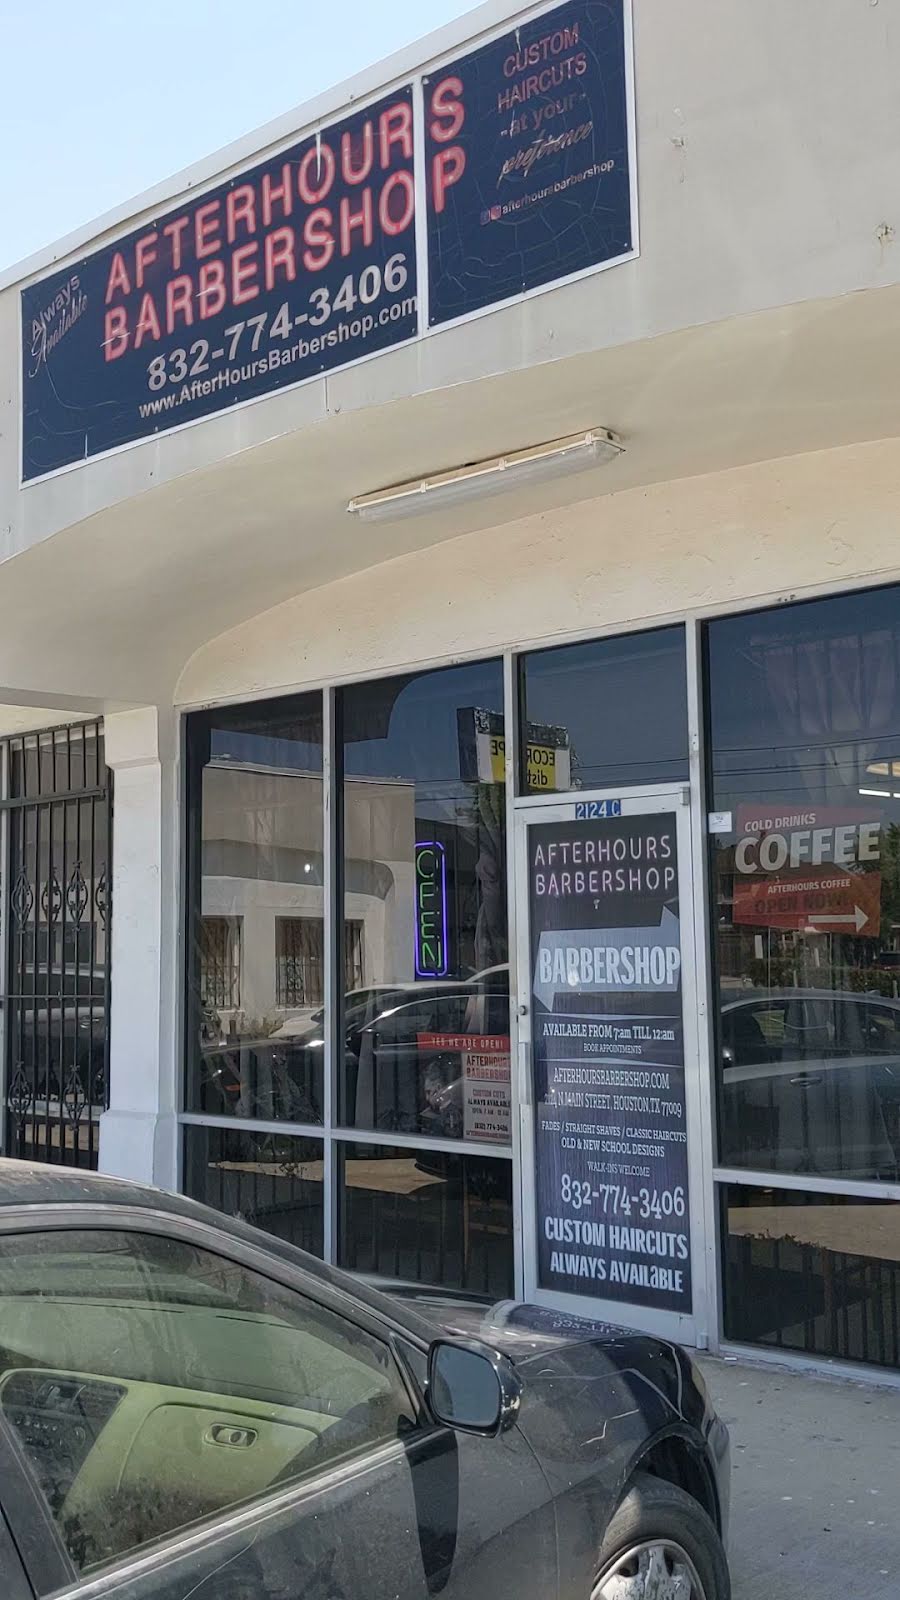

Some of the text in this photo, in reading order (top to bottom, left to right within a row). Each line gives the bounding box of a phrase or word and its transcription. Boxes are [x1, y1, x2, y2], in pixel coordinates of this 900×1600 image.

[503, 23, 579, 78] CUSTOM
[498, 53, 588, 113] HAIRCUTS
[104, 76, 465, 304] AFTERHOURS
[102, 146, 466, 363] BARBERSHOP
[32, 275, 80, 341] Always
[147, 252, 408, 391] 832-774-3406
[138, 294, 418, 419] www.AfterHoursBarbershop.com
[576, 800, 620, 819] 2124 C
[745, 813, 816, 832] COLD DRINKS
[535, 835, 671, 866] AFTERHOURS
[735, 822, 881, 874] COFFEE
[536, 867, 675, 896] BARBERSHOP
[768, 878, 851, 895] AFTERHOURS COFFEE
[754, 895, 797, 914] OPEN
[539, 945, 681, 986] BARBERSHOP
[462, 1038, 476, 1048] ARE
[543, 1022, 587, 1037] AVAILABLE
[588, 1024, 612, 1038] FROM
[632, 1026, 651, 1040] TILL
[653, 1029, 674, 1041] 12:am
[583, 1043, 642, 1054] BOOK APPOINTMENTS
[554, 1068, 670, 1089] AFTERHOURSBARBERSHOP.COM
[661, 1102, 682, 1118] 77009
[541, 1121, 560, 1131] FADES
[565, 1122, 596, 1135] STRAIGHT
[596, 1125, 621, 1137] SHAVES
[626, 1128, 652, 1139] CLASSIC
[653, 1130, 687, 1143] HAIRCUTS
[561, 1138, 665, 1157] OLD & NEW SCHOOL DESIGNS
[587, 1161, 650, 1176] WALK-INS WELCOME
[561, 1173, 685, 1220] 832-774-3406
[544, 1216, 688, 1260] CUSTOM HAIRCUTS
[550, 1251, 606, 1281] ALWAYS
